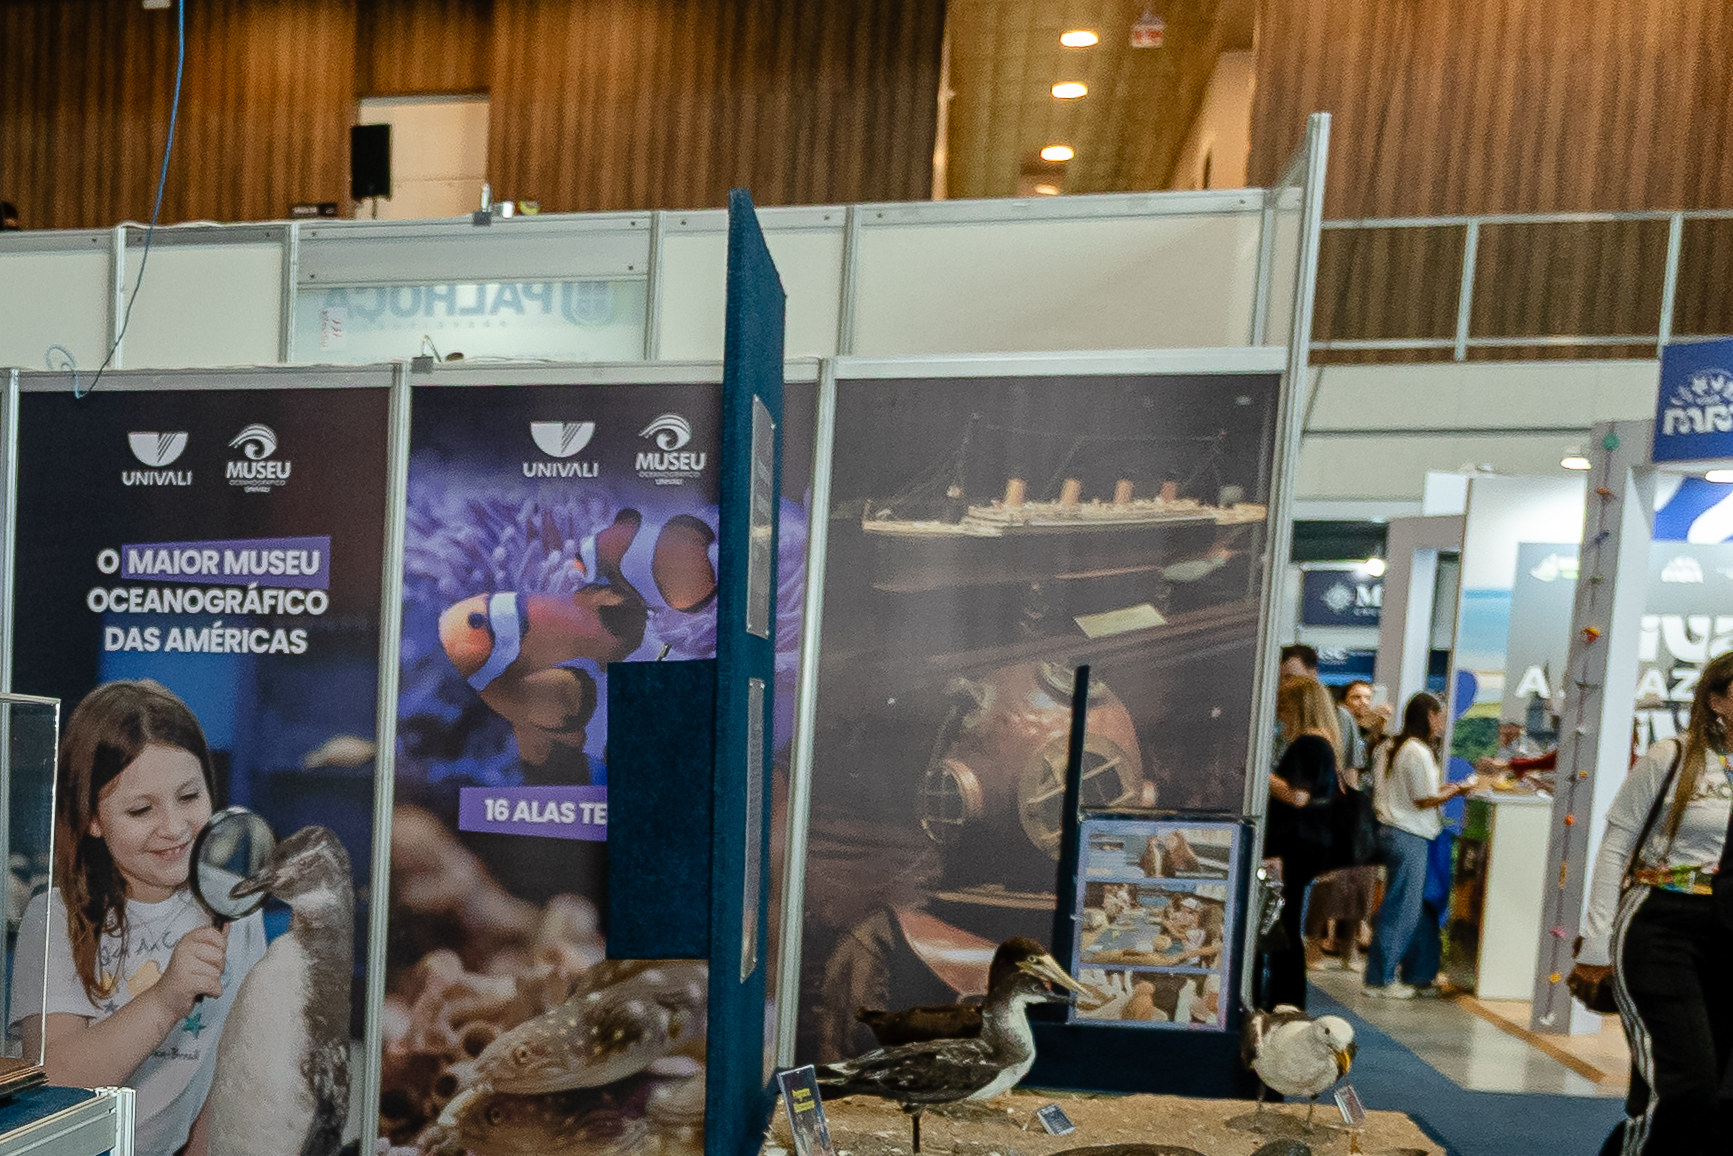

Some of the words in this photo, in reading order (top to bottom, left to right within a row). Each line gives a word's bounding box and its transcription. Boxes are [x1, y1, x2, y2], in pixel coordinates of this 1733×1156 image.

[226, 461, 291, 479] MUSEU
[523, 461, 599, 478] UNIVALI
[635, 452, 707, 471] MUSEU
[122, 471, 192, 486] UNIVALI
[96, 549, 120, 575] O
[127, 549, 220, 575] MAIOR
[224, 549, 320, 576] MUSEU
[87, 581, 329, 615] OCEANOGRÁFICO
[104, 626, 162, 652] DAS
[164, 620, 308, 655] AMÉRICAS
[484, 798, 509, 822] 16
[512, 800, 576, 824] ALAS
